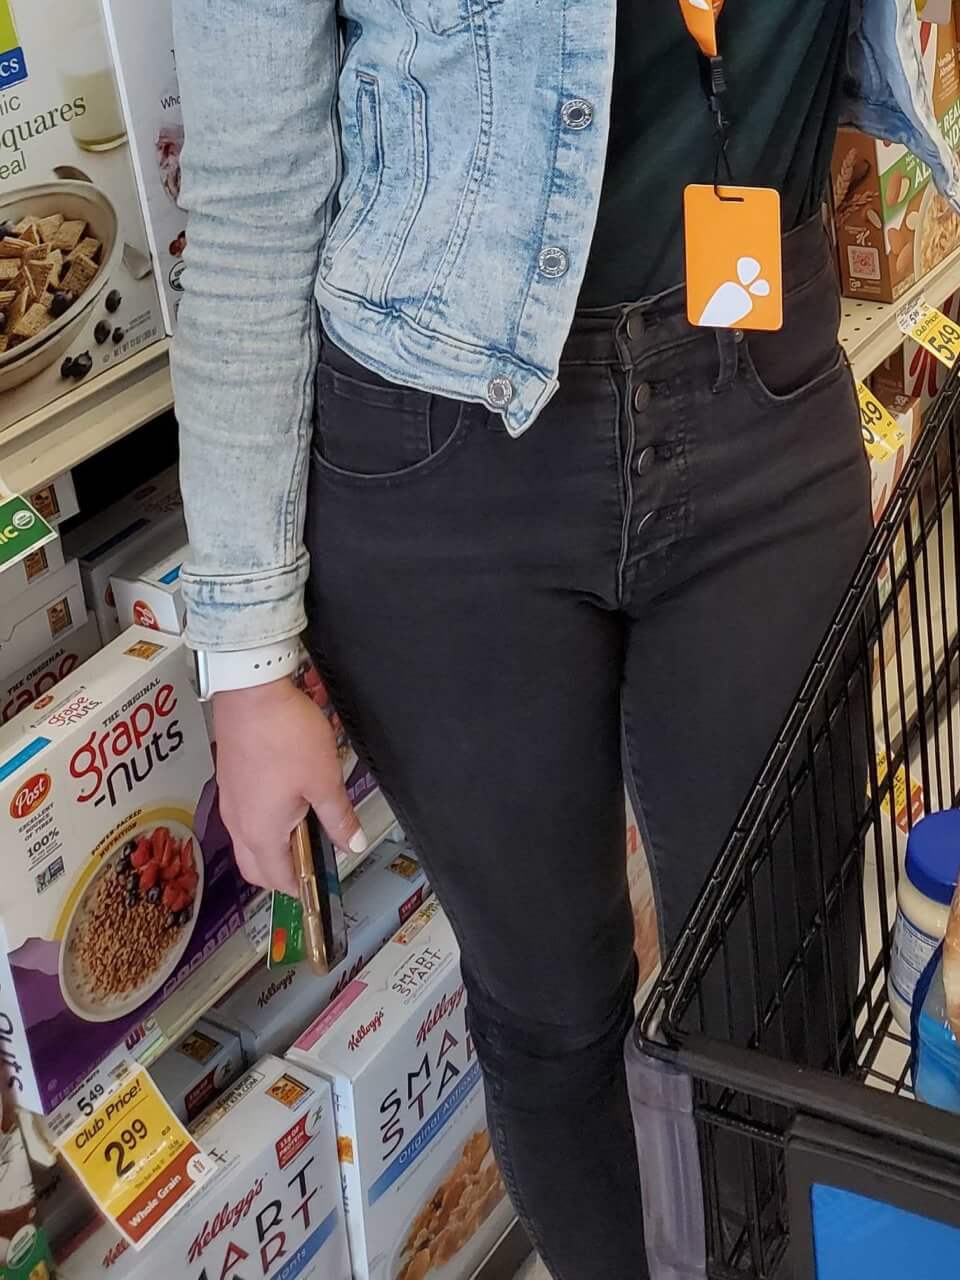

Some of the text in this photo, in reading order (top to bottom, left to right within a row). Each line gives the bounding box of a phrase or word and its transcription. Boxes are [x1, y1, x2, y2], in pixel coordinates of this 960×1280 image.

[927, 323, 960, 362] 549
[8, 647, 66, 696] THE ORIGINAL
[48, 696, 88, 728] grape
[102, 677, 161, 729] THE ORIGINAL
[69, 684, 178, 803] grape
[93, 720, 186, 808] -nuts
[16, 778, 46, 817] Post
[19, 802, 55, 833] EXCELLENT
[28, 827, 60, 858] 100%
[392, 947, 434, 993] SMART
[400, 952, 441, 997] START
[347, 1007, 385, 1053] Kellogg's
[74, 1117, 105, 1150] Club
[104, 1078, 144, 1121] Price!
[77, 1083, 105, 1117] 549
[104, 1117, 149, 1178] 299
[127, 1173, 183, 1229] Whole Grain
[187, 1177, 265, 1265] Kellogg's
